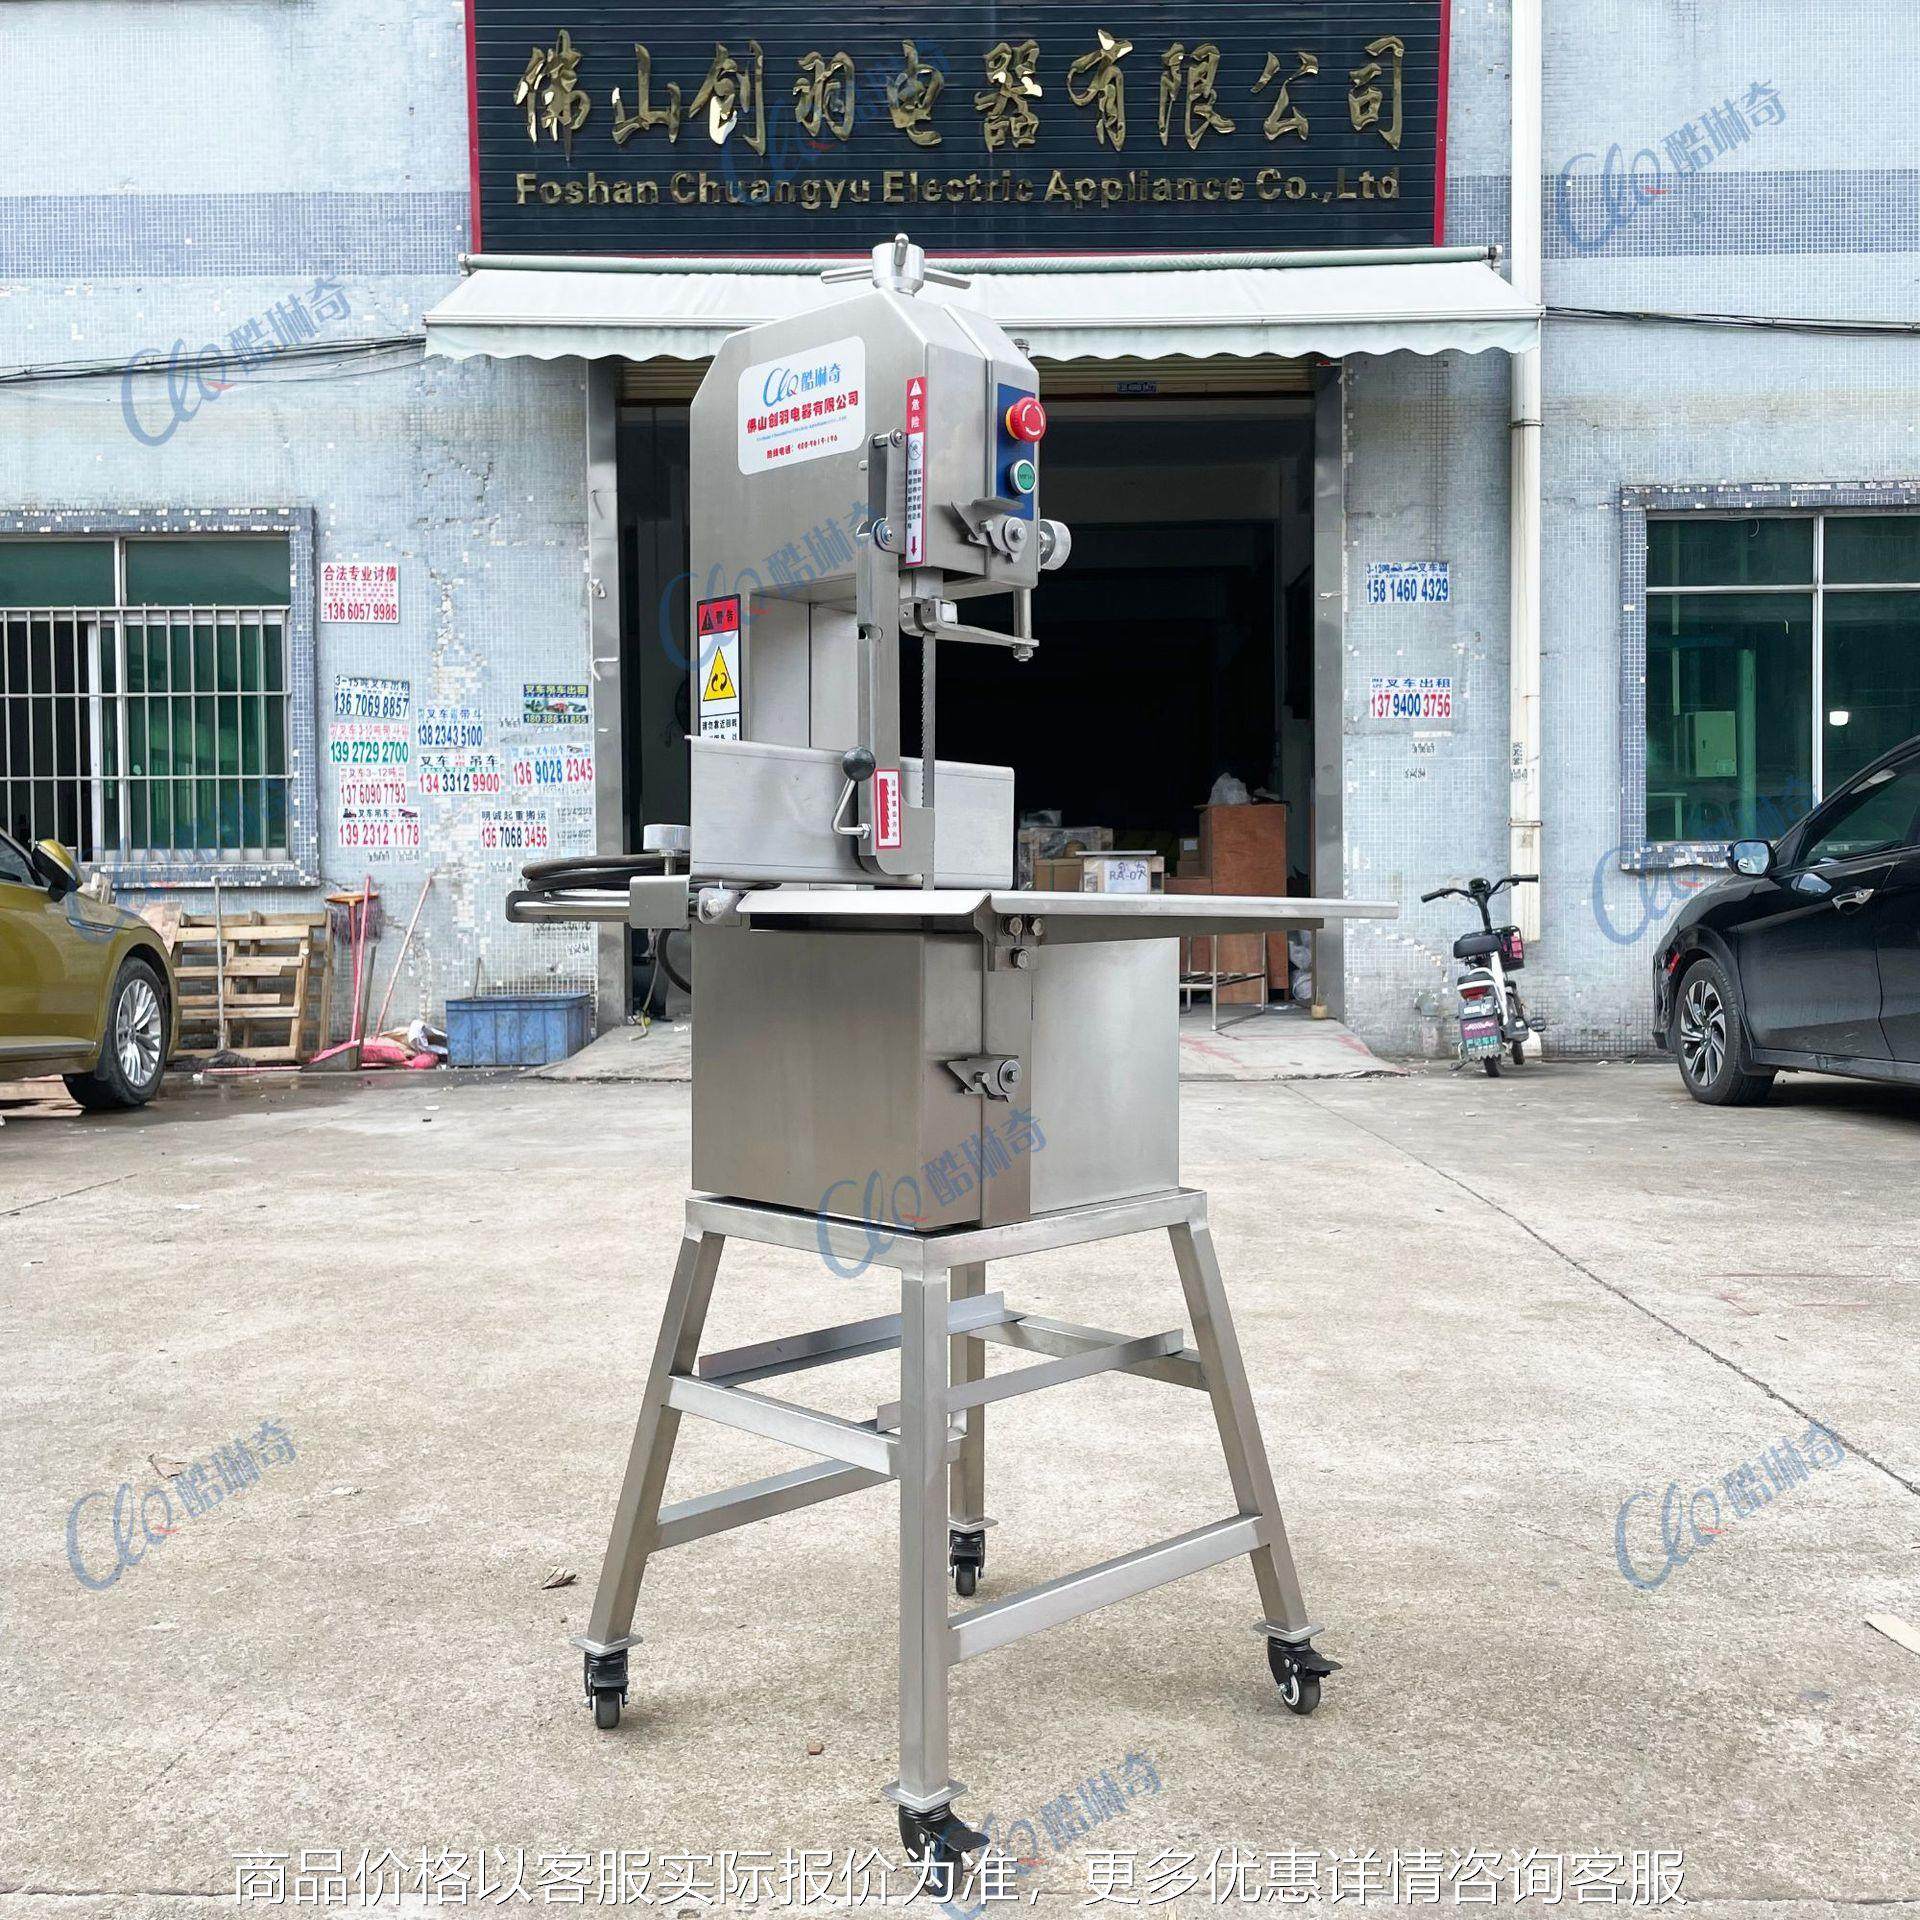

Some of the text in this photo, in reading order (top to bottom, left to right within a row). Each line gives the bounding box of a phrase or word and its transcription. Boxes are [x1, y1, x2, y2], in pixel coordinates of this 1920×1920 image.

[514, 29, 1404, 165] 佛山创羽电器有限公司
[515, 168, 1400, 209] Foshan Chuangyu Electric Appliance Co.,Ltd
[1367, 578, 1448, 602] 158 1460 4329
[328, 603, 397, 620] 136 6057 9986
[1386, 678, 1451, 688] 叉车出租
[335, 692, 409, 718] 136 7069 8857
[1371, 693, 1451, 717] 137 9400 3756
[418, 725, 482, 746] 138 2343 5100
[331, 741, 409, 763] 139 2729 2700
[420, 755, 447, 767] 叉车
[514, 758, 593, 785] 136 9028 2345
[341, 783, 406, 804] 137 6090 7793
[420, 773, 500, 793] 134 3312 9900
[340, 824, 420, 845] 139 2312 1178
[481, 827, 497, 847] 136
[499, 826, 522, 848] 7068
[524, 827, 547, 848] 3456
